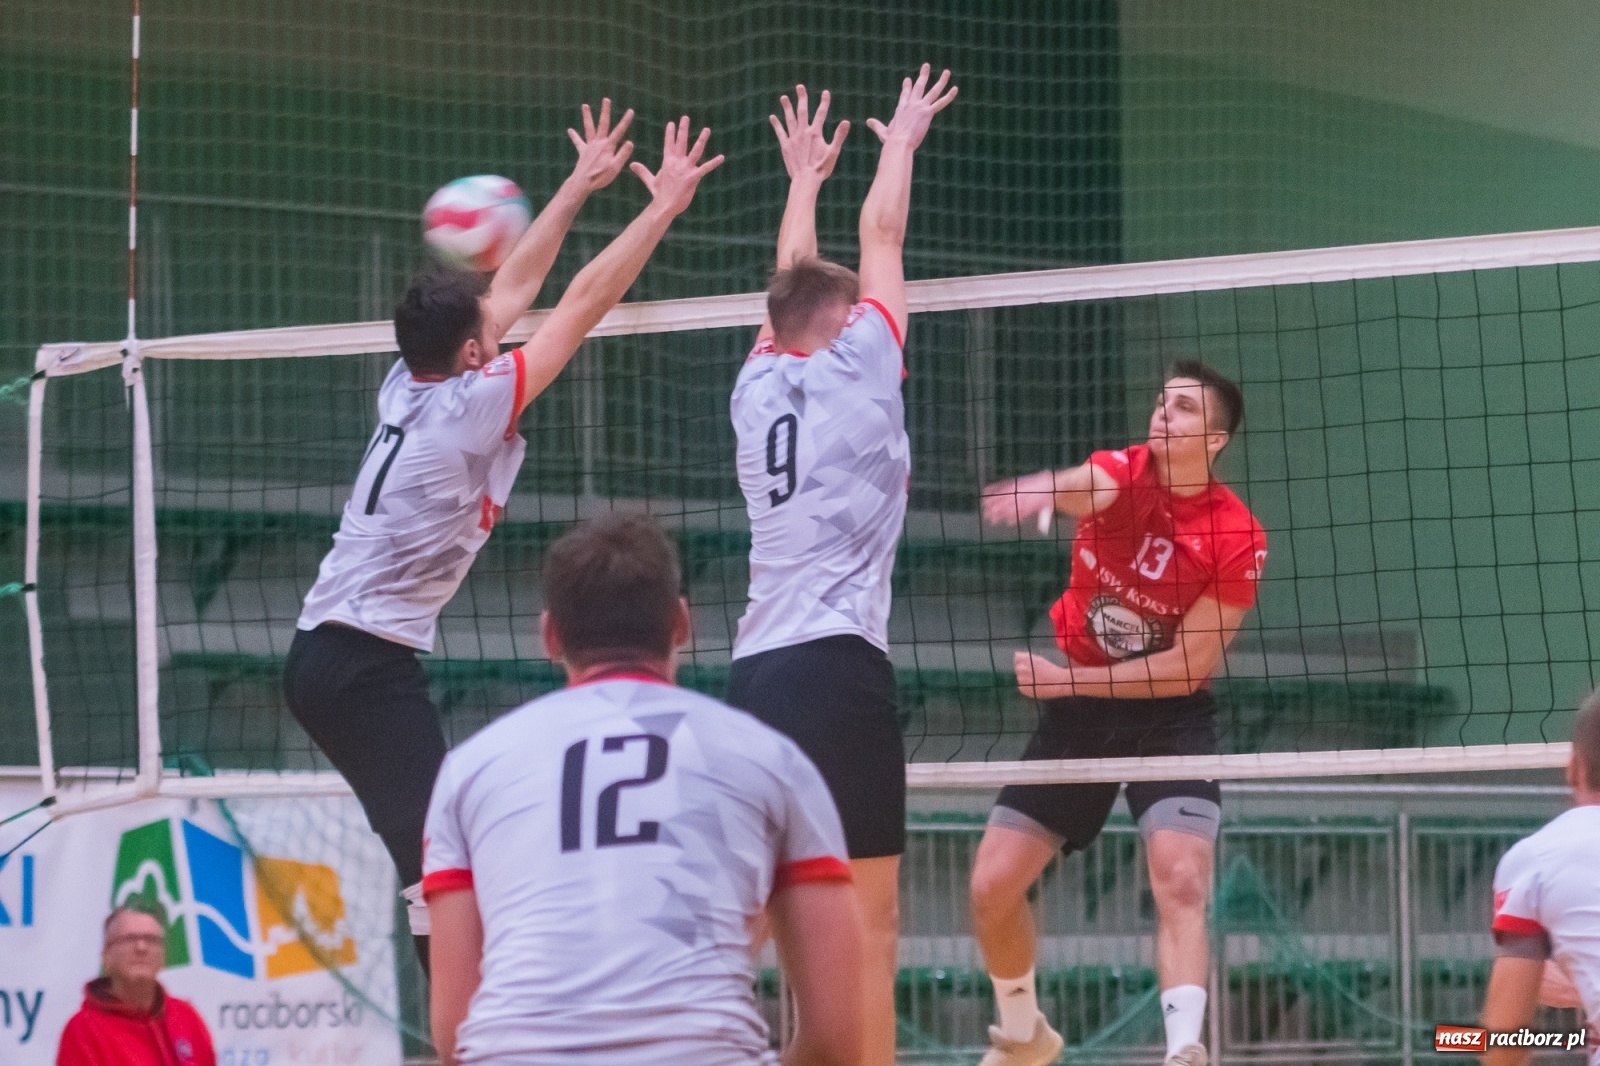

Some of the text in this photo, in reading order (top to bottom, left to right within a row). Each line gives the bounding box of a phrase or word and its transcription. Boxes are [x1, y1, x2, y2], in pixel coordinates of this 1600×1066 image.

[766, 412, 798, 507] 9
[1130, 532, 1174, 580] 13
[1126, 587, 1169, 616] KOKS
[559, 733, 669, 854] 12
